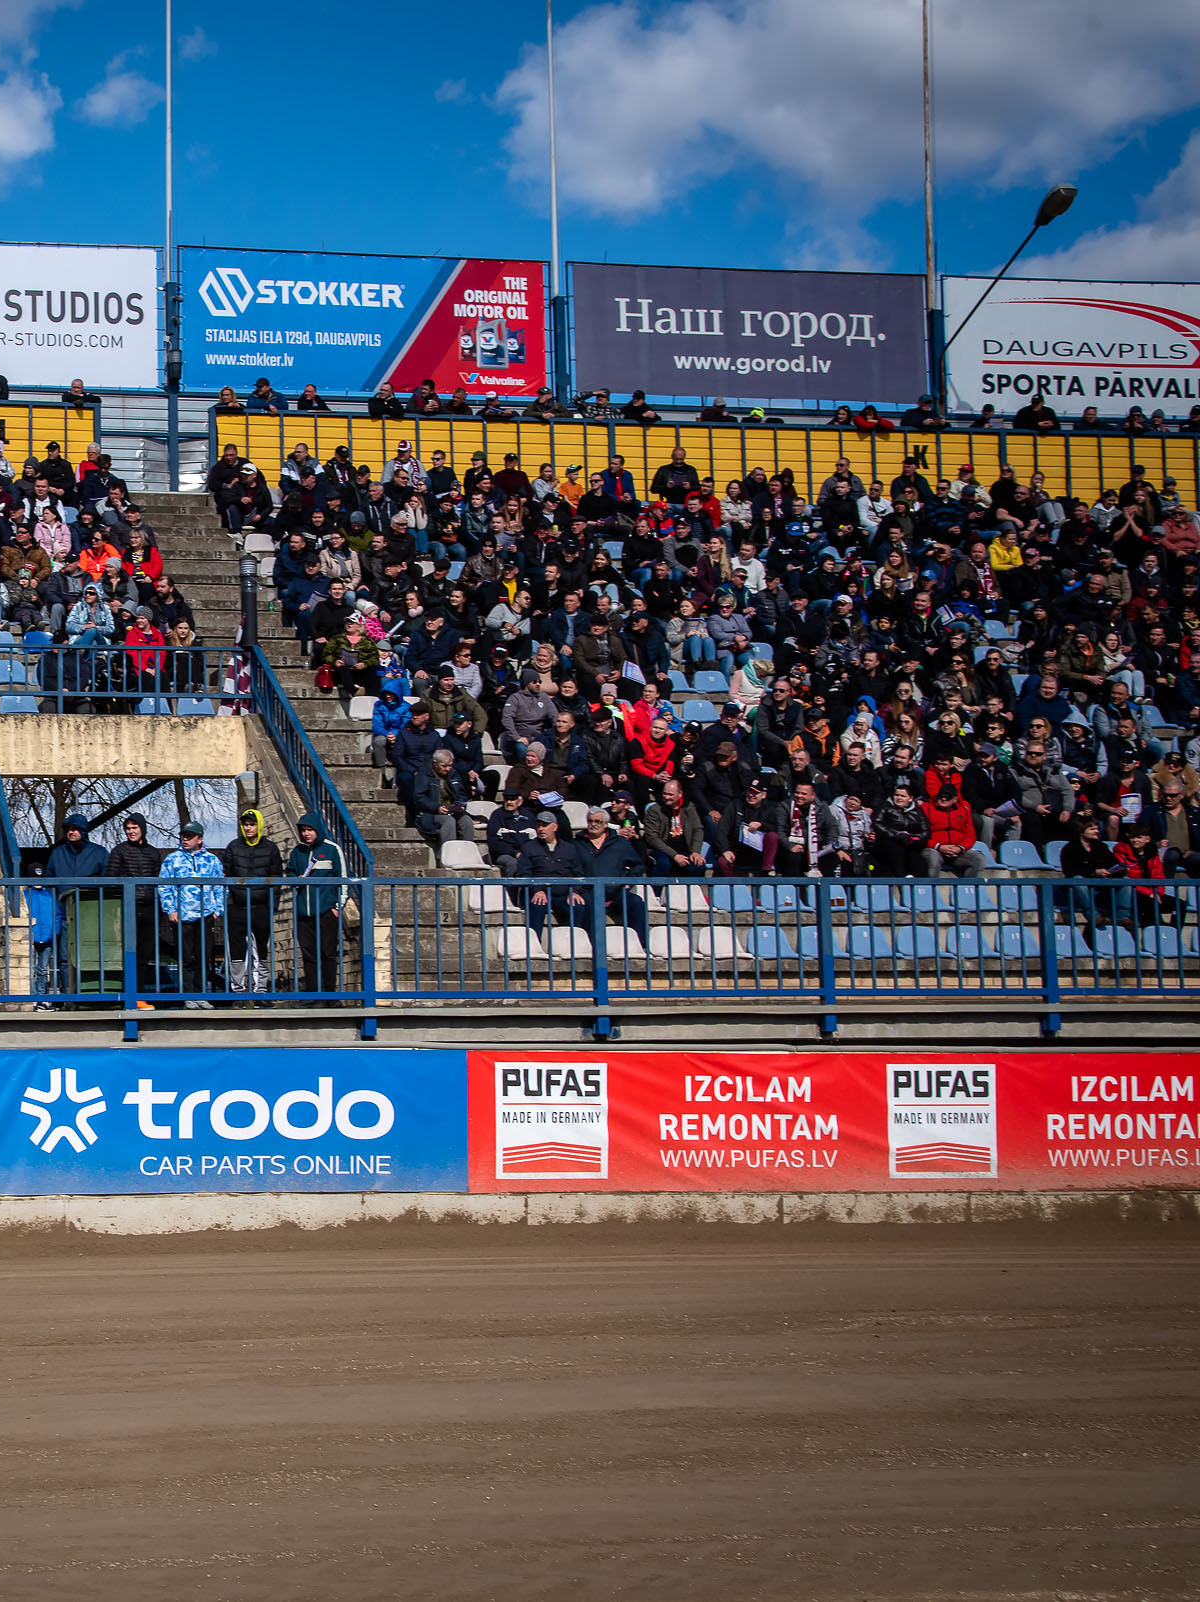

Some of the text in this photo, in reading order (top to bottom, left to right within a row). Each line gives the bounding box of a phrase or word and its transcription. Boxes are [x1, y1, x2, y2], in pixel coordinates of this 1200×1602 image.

[503, 276, 528, 290] THE
[256, 280, 404, 308] STOKKER
[464, 290, 528, 306] ORIGINAL
[4, 289, 145, 325] STUDIOS
[453, 303, 529, 320] MOTOR OIL
[615, 297, 887, 347] Наш город.
[205, 328, 382, 348] STACIJAS IELA 129d, DAUGAVPILS
[205, 352, 294, 367] www.stokker.lv
[983, 339, 1189, 360] DAUGAVPILS
[674, 355, 832, 374] www.gorod.lv
[479, 376, 527, 386] Valvoline
[982, 371, 1200, 399] SPORTA PĀRVAL
[502, 1068, 600, 1097] PUFAS
[685, 1075, 811, 1102] IZCILAM
[893, 1070, 989, 1098] PUFAS
[1071, 1075, 1194, 1102] IZCILAM
[122, 1076, 395, 1140] trodo
[502, 1111, 601, 1124] MADE IN GERMANY
[894, 1112, 990, 1125] MADE IN GERMANY
[659, 1114, 839, 1141] REMONTAM
[1047, 1113, 1200, 1140] REMONTA
[140, 1155, 391, 1176] CAR PARTS ONLINE
[660, 1149, 838, 1168] WWW.PUFAS.LV
